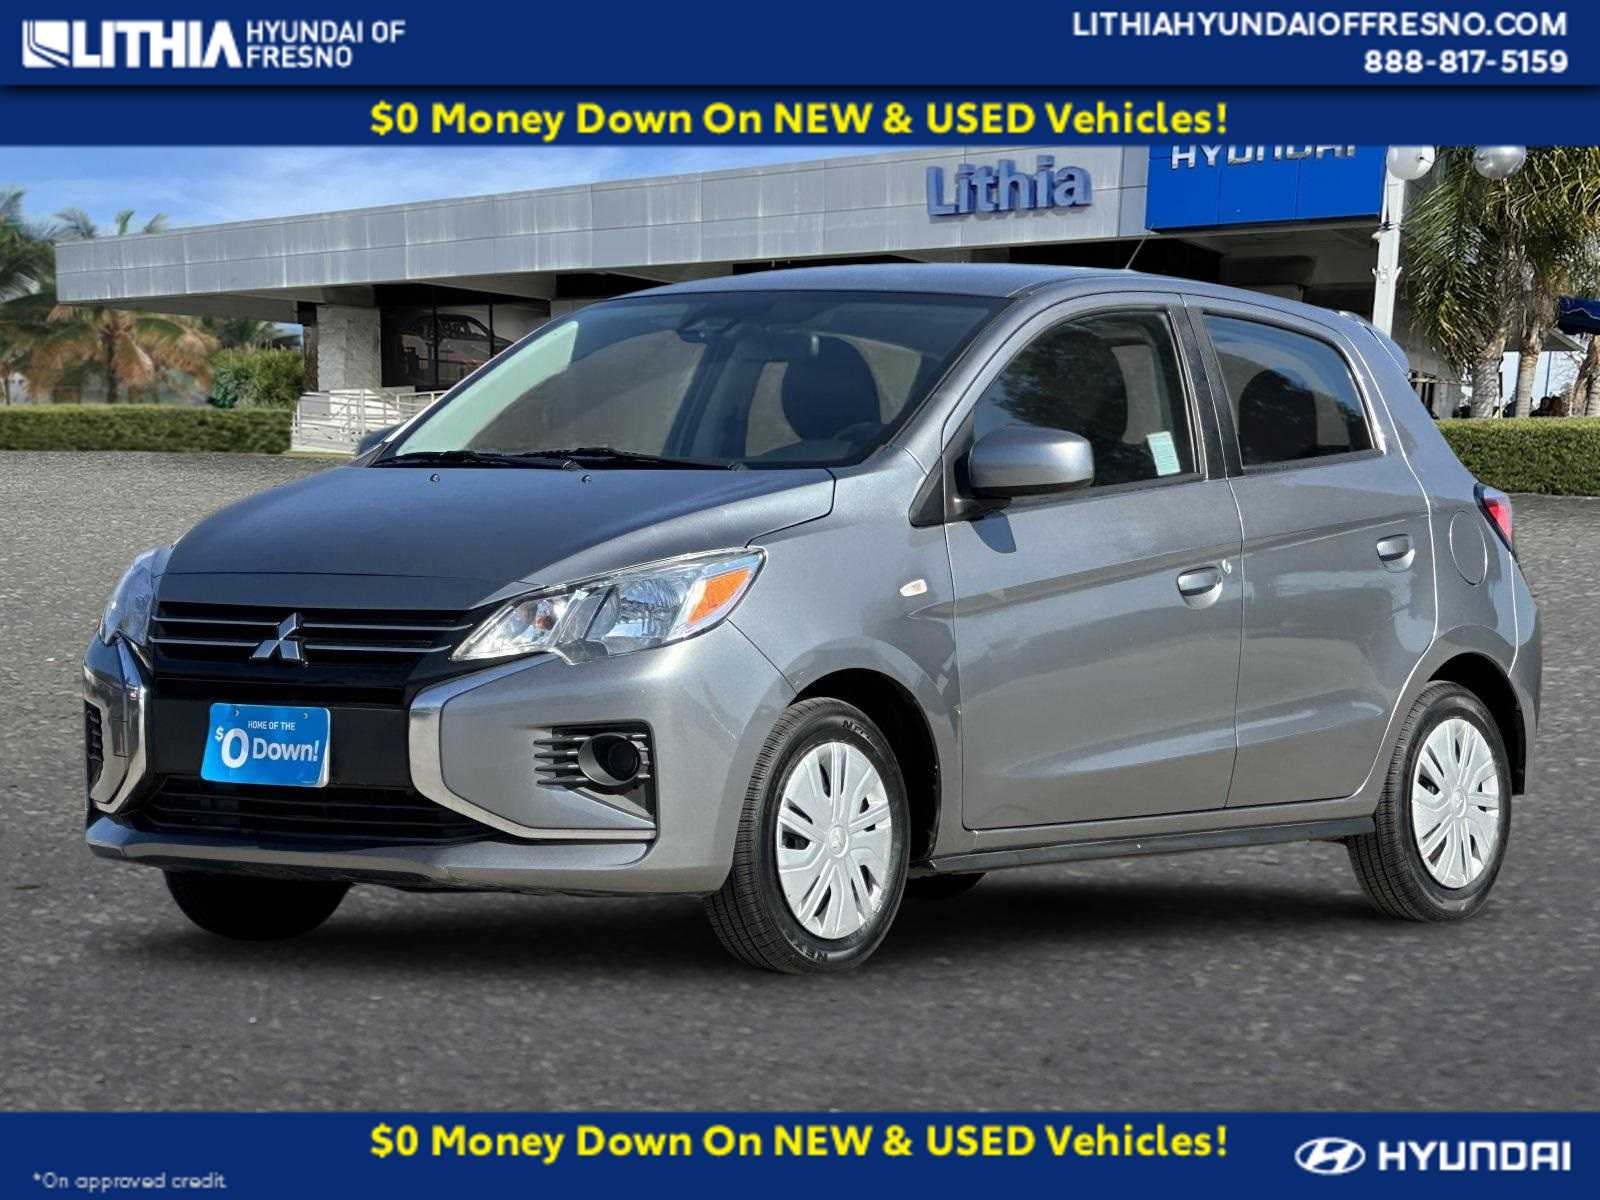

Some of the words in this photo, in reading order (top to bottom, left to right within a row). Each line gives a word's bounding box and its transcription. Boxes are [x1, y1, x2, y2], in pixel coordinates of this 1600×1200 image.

[926, 155, 1093, 216] Lithia
[248, 720, 267, 730] HOME
[268, 721, 279, 730] OF
[281, 722, 296, 731] THE
[252, 737, 319, 762] Down!
